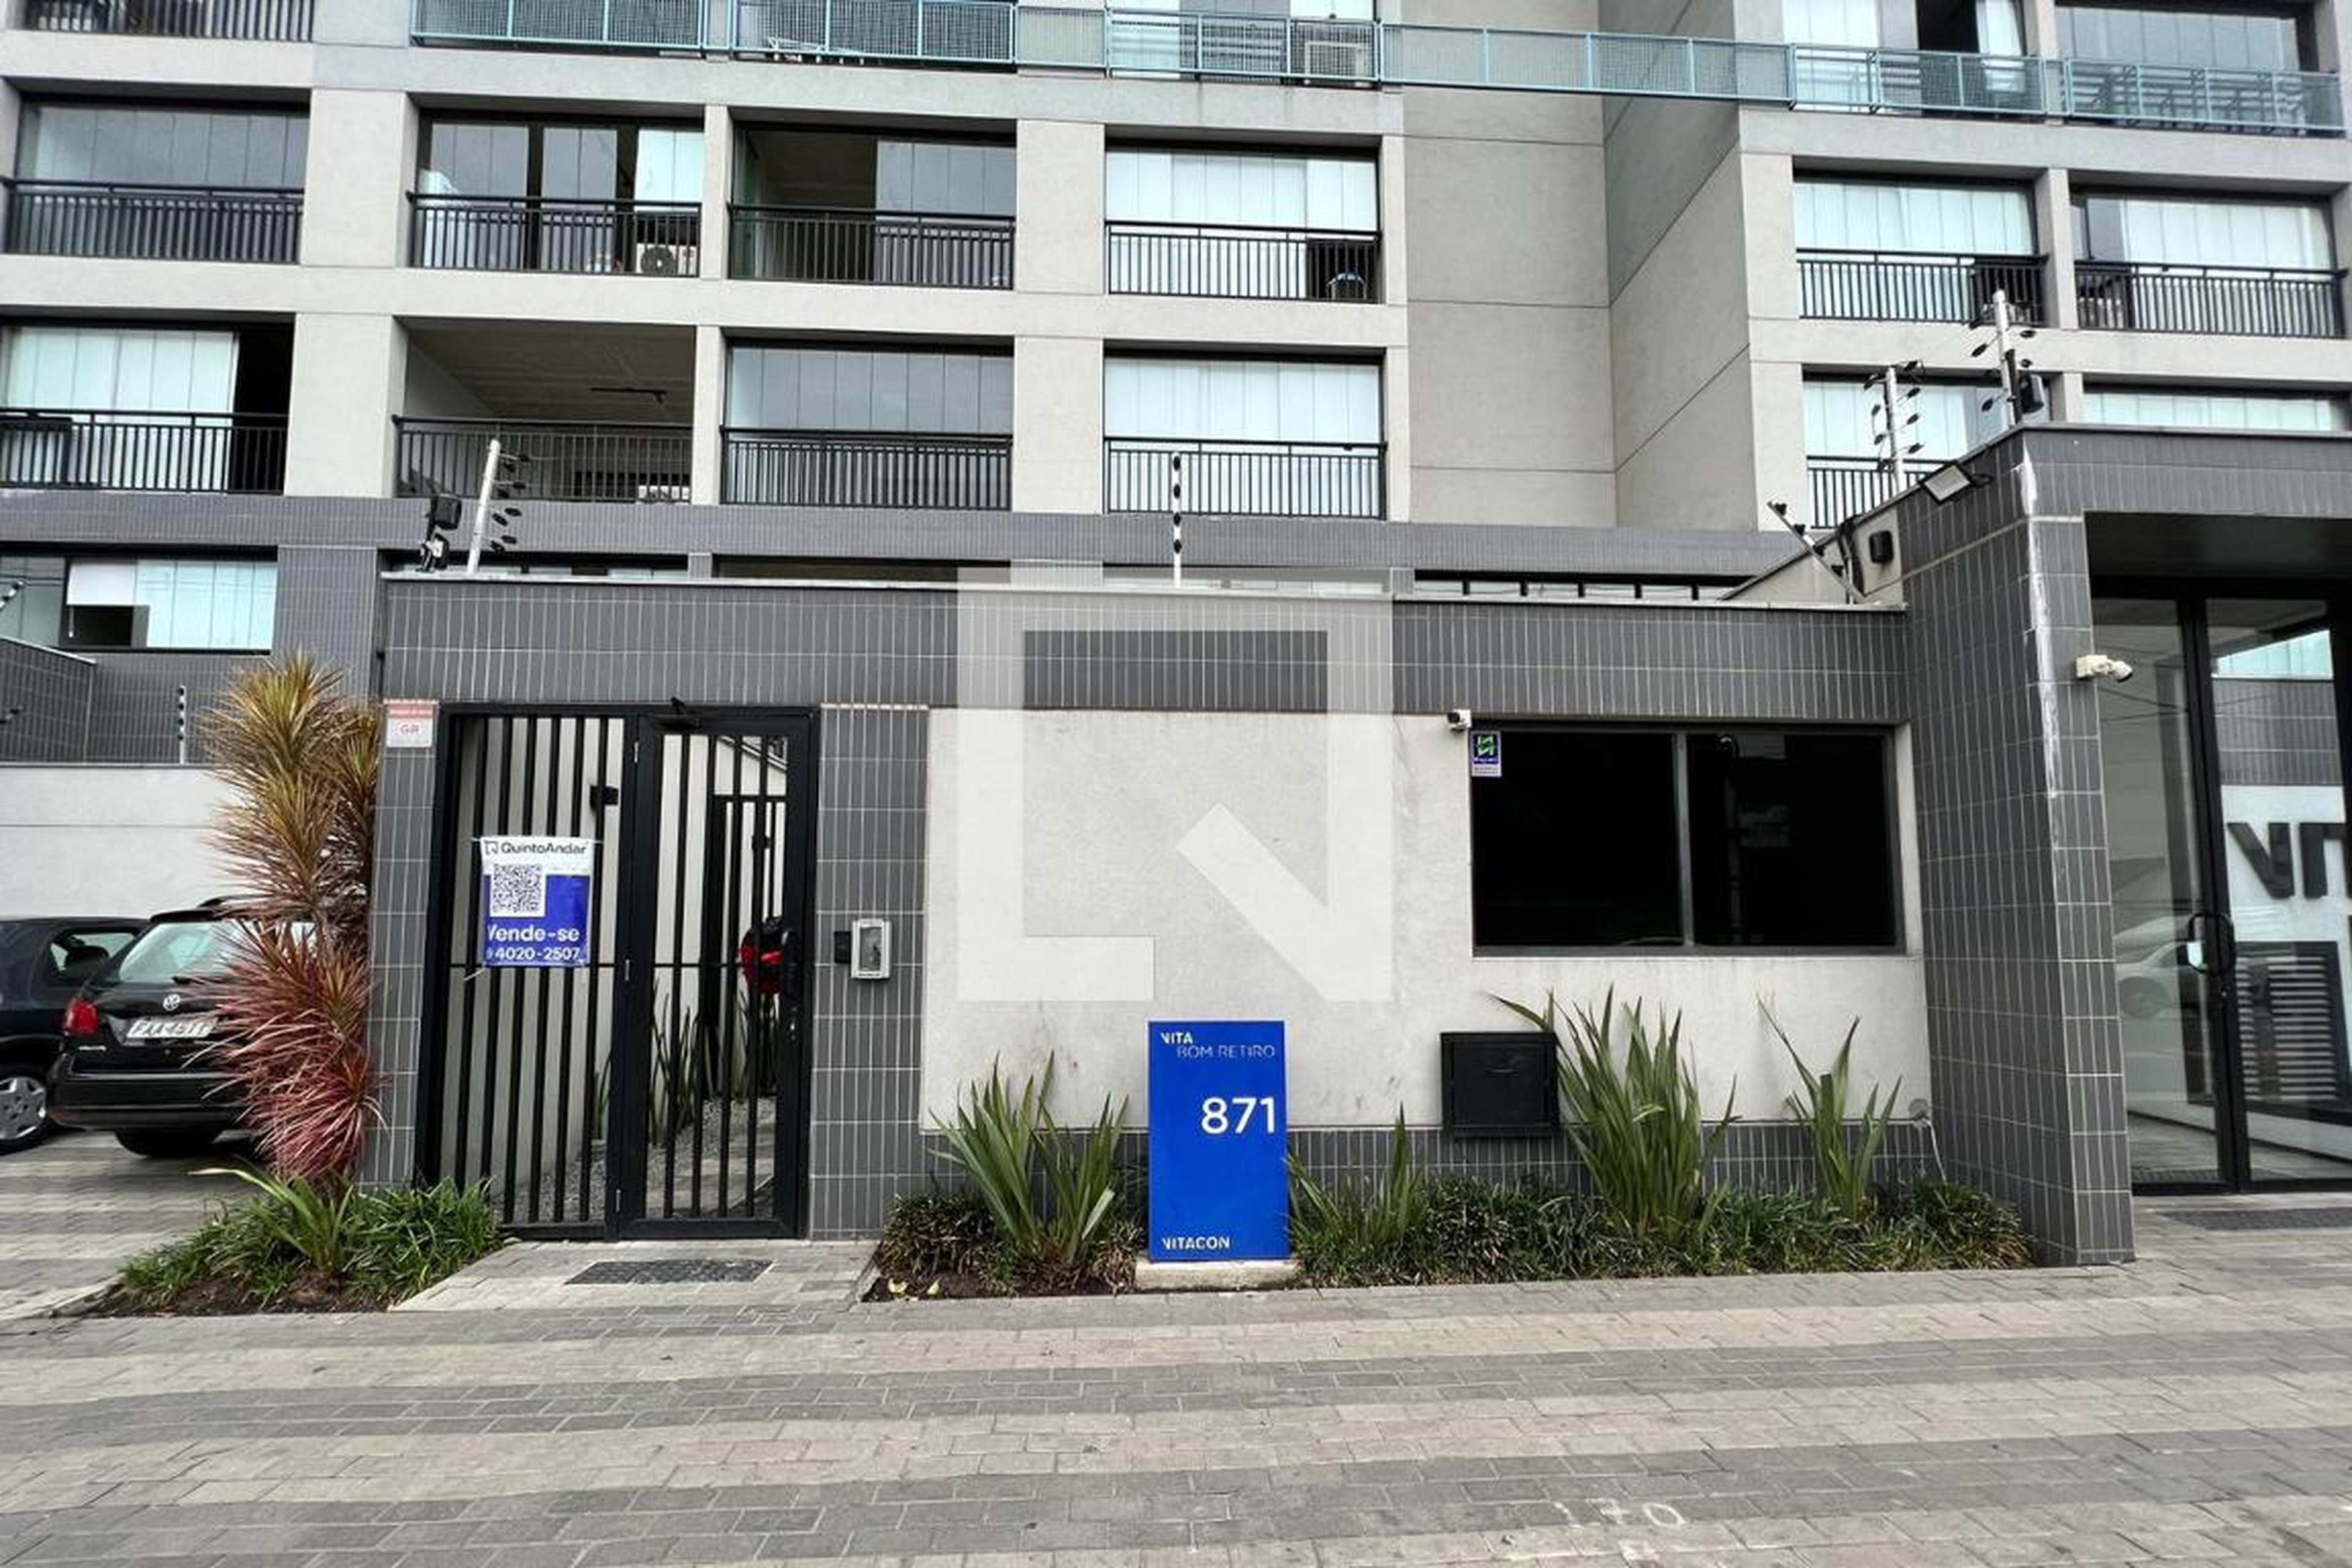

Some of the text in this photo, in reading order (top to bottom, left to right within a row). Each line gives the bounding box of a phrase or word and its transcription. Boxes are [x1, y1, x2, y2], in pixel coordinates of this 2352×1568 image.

[501, 842, 587, 854] QuintoAndar
[488, 924, 580, 941] Vende-se
[494, 947, 581, 960] 4020-2507
[1161, 1032, 1193, 1044] VITA
[1177, 1045, 1275, 1058] BOM RETIRO
[1201, 1096, 1275, 1134] 871
[1161, 1236, 1230, 1250] VITACON
